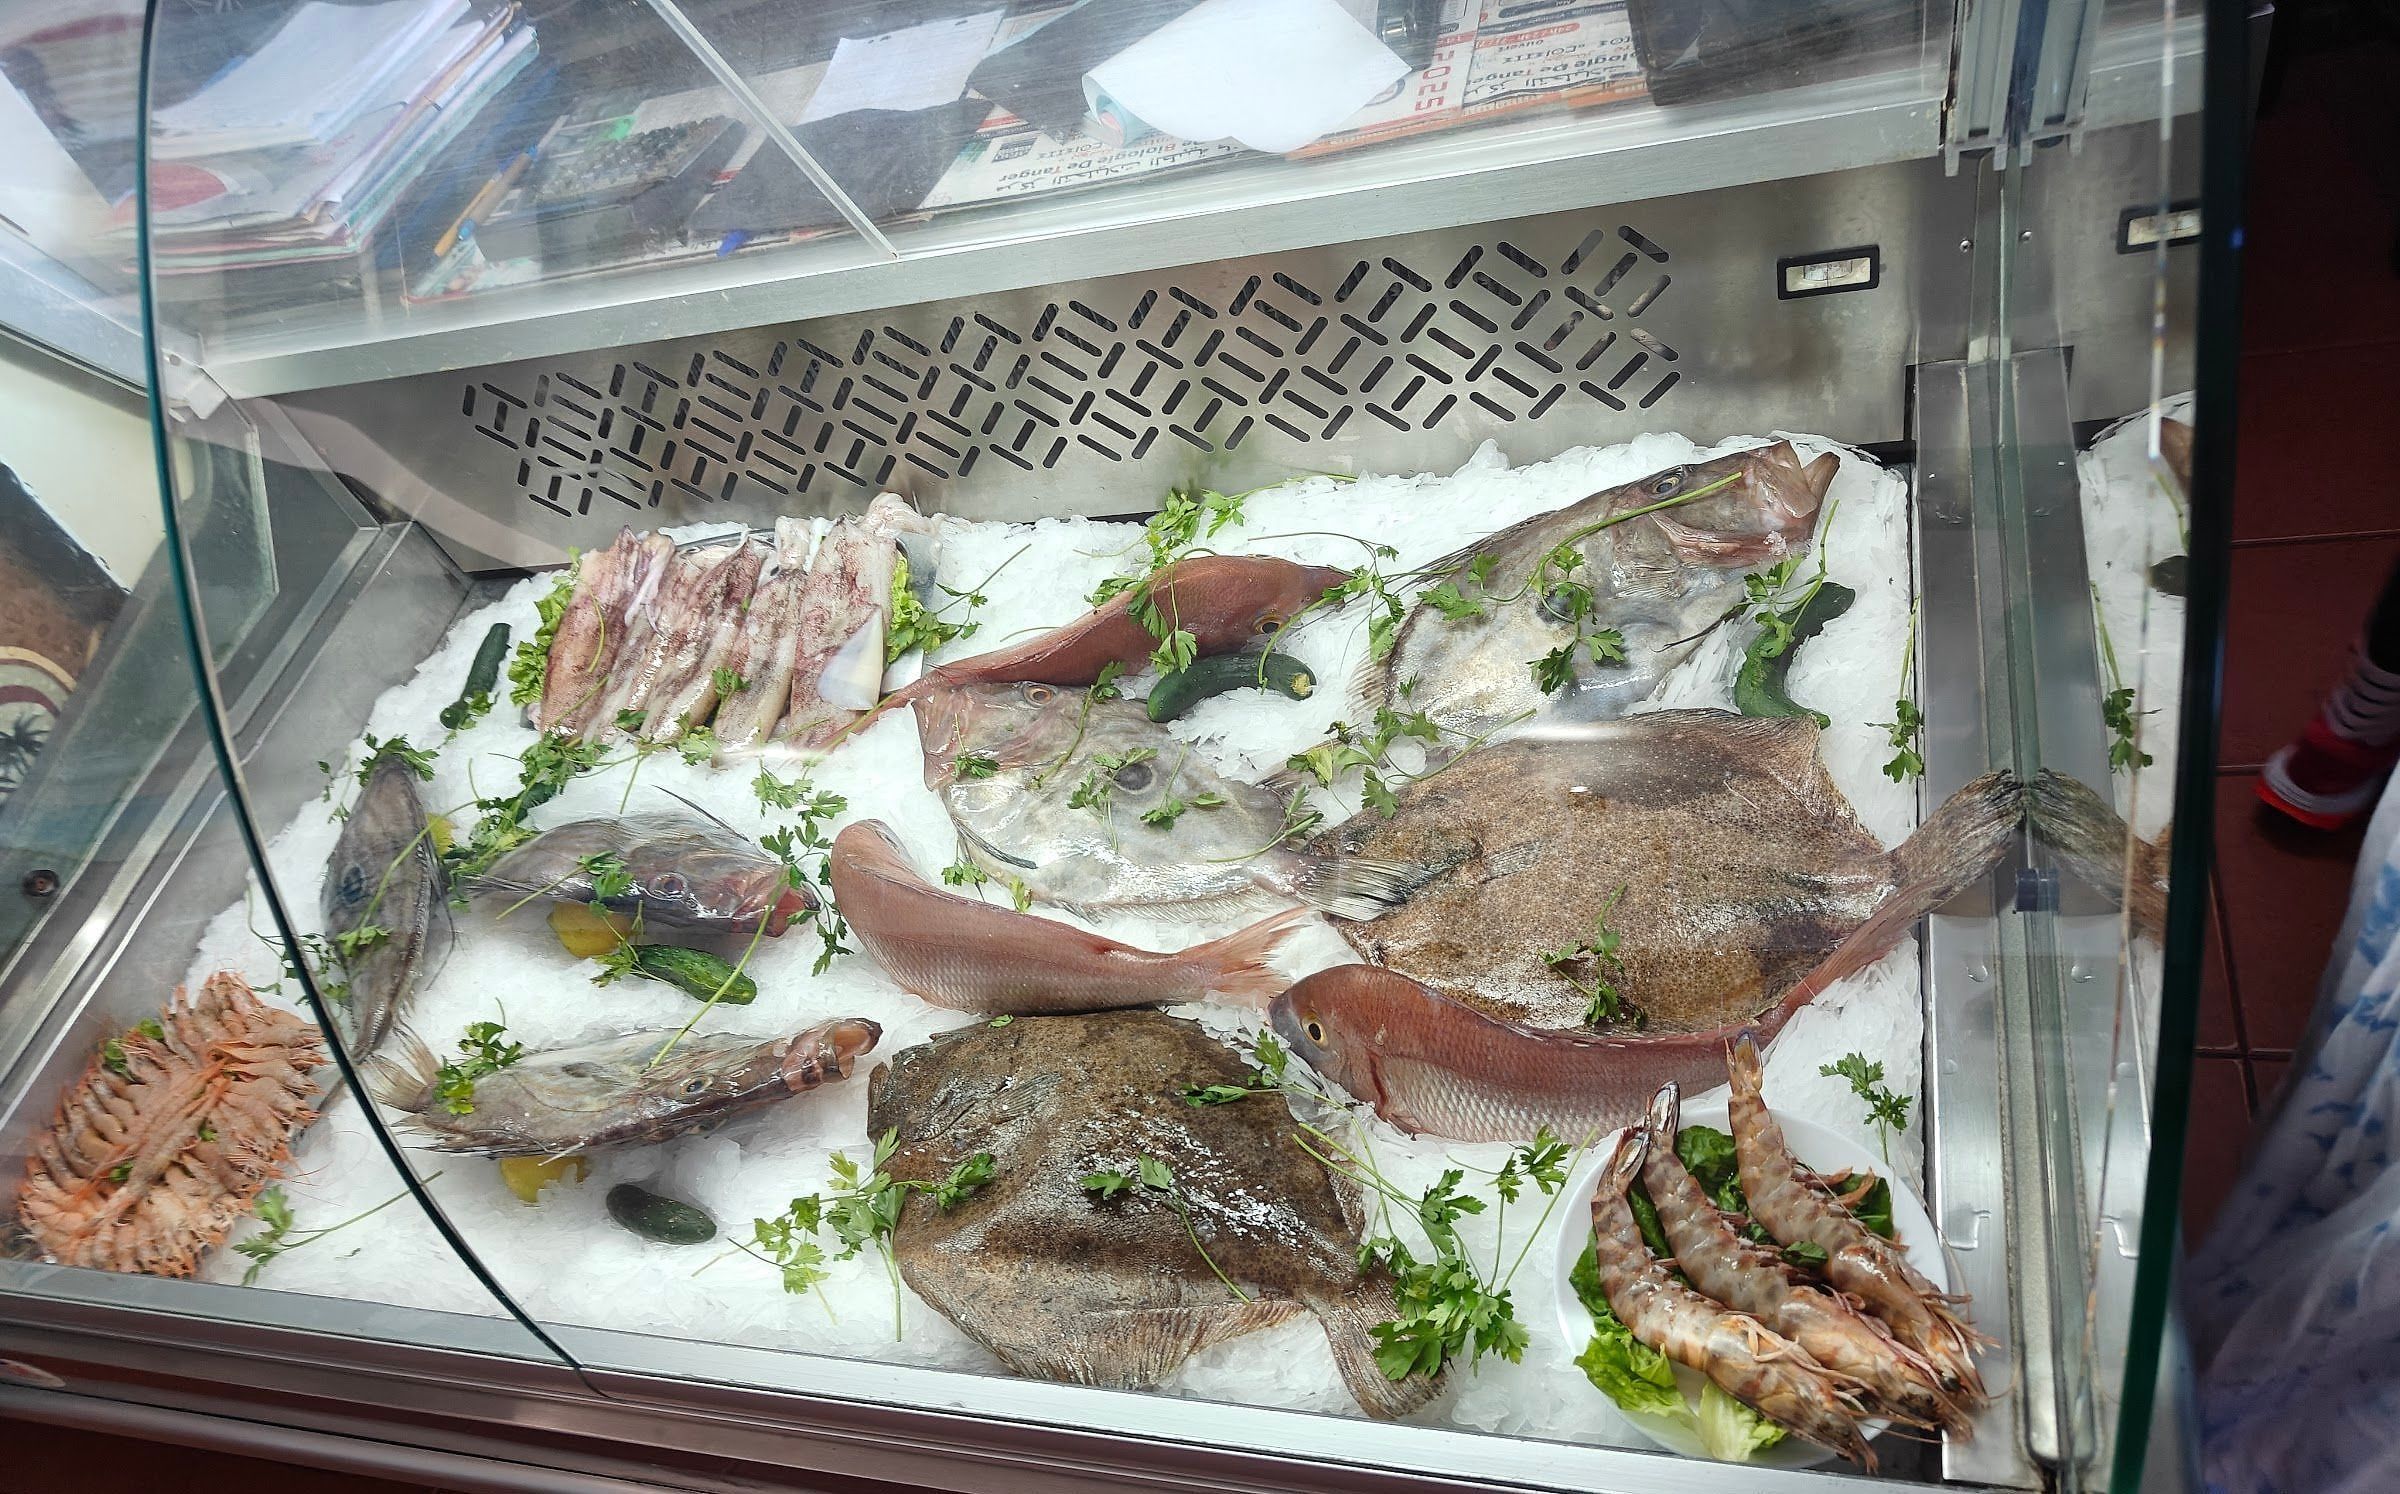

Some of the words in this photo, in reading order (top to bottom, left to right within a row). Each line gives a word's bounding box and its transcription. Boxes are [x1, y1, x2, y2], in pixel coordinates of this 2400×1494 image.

[1574, 52, 1638, 68] ologie
[1097, 143, 1176, 164] Biologie
[1067, 160, 1093, 170] De
[999, 165, 1063, 182] Tanger
